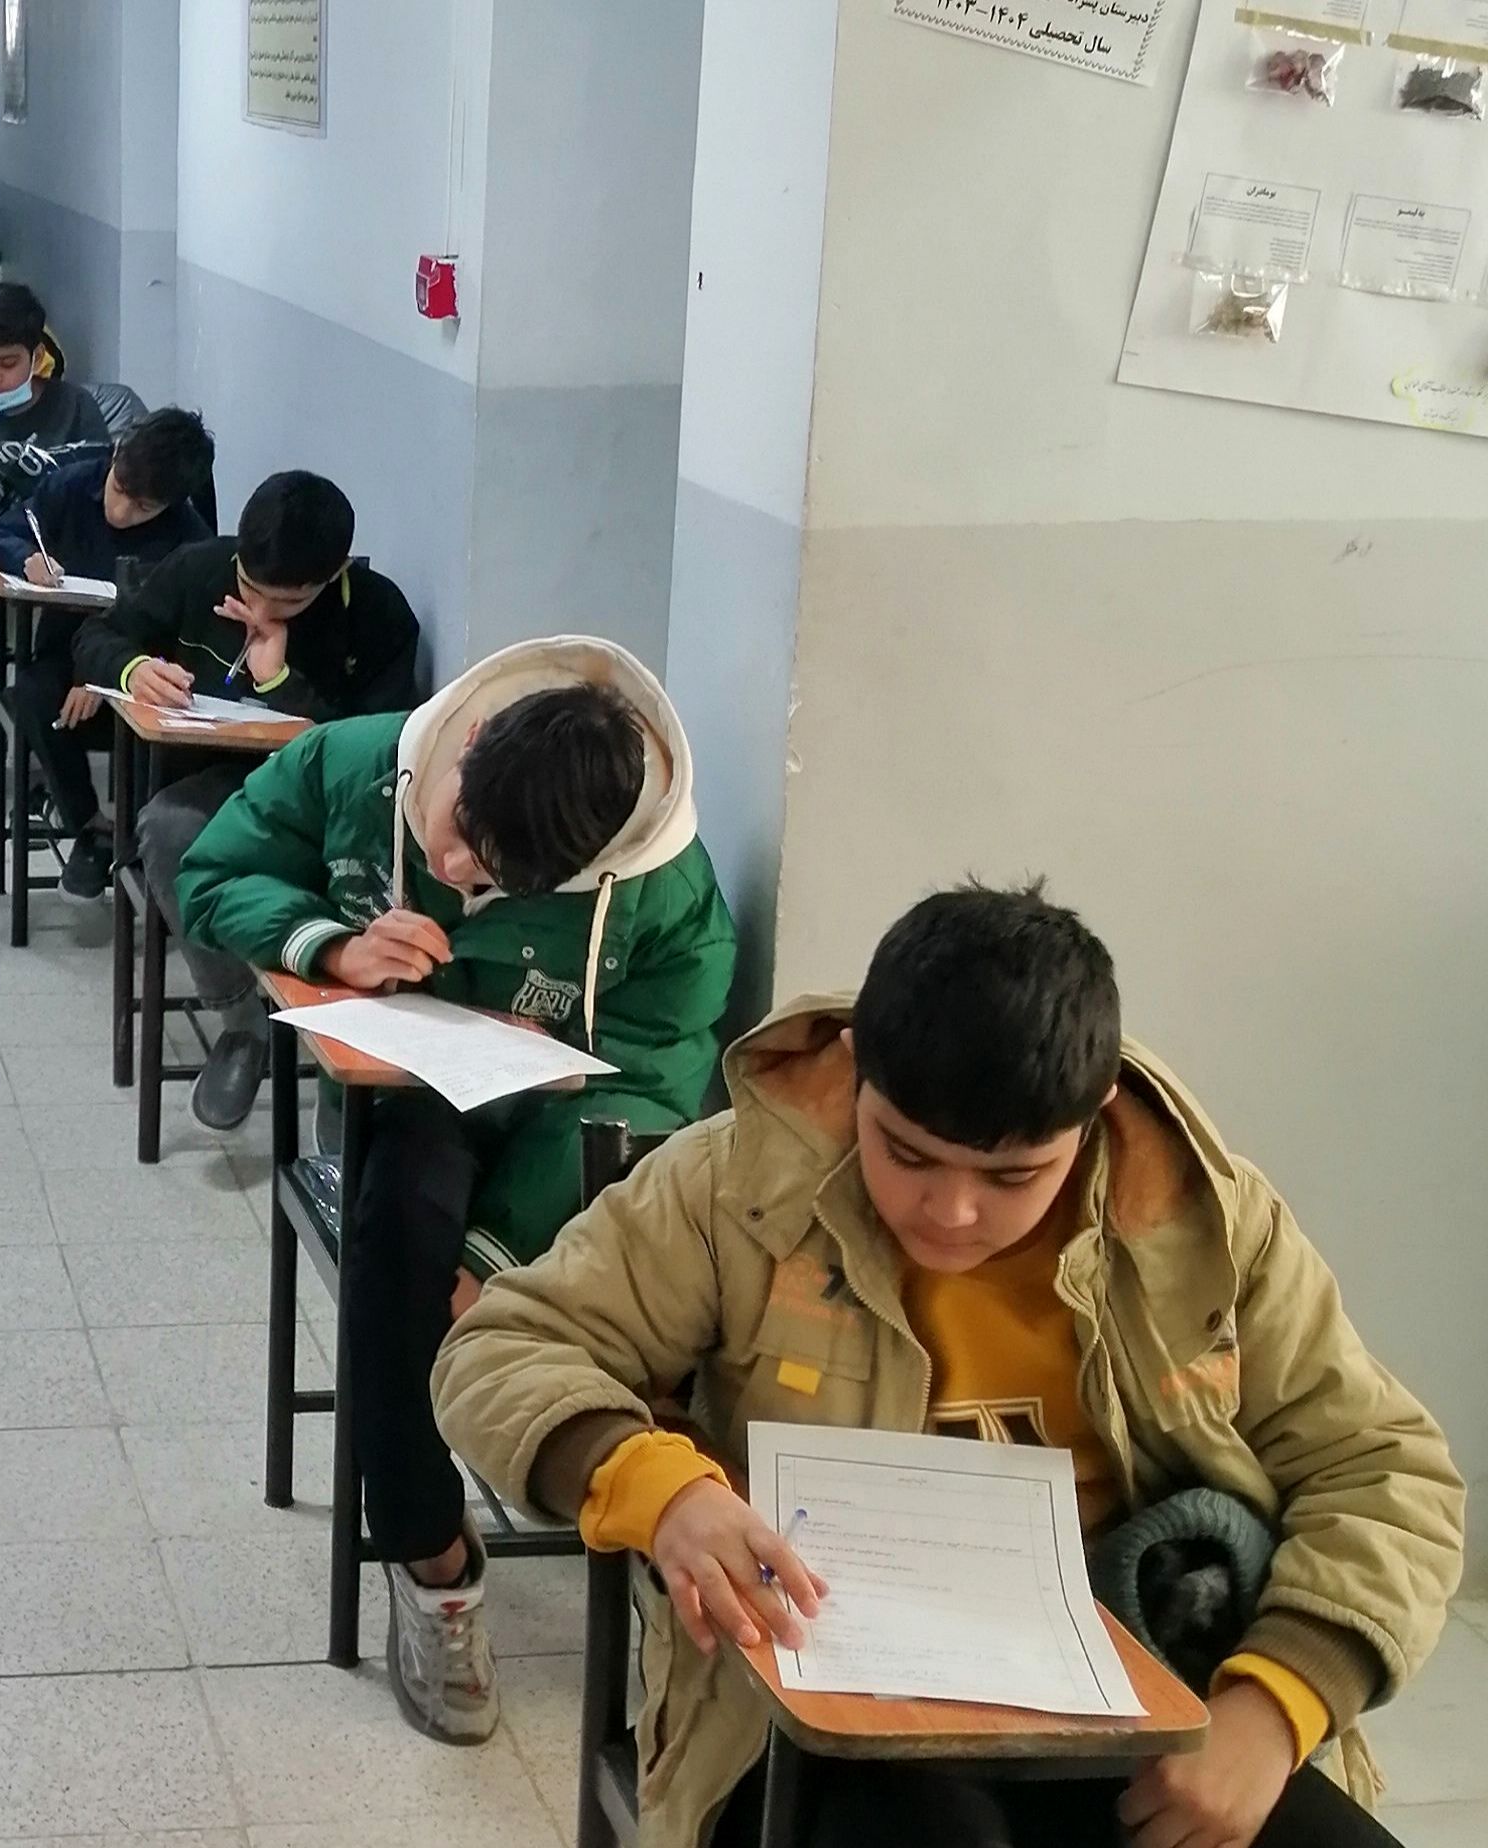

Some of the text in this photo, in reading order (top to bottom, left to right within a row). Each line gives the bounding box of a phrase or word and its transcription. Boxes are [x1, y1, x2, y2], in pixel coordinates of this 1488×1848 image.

[1100, 2, 1149, 25] دبیرستان
[1029, 21, 1085, 46] تحصیلی
[1084, 34, 1112, 54] سال
